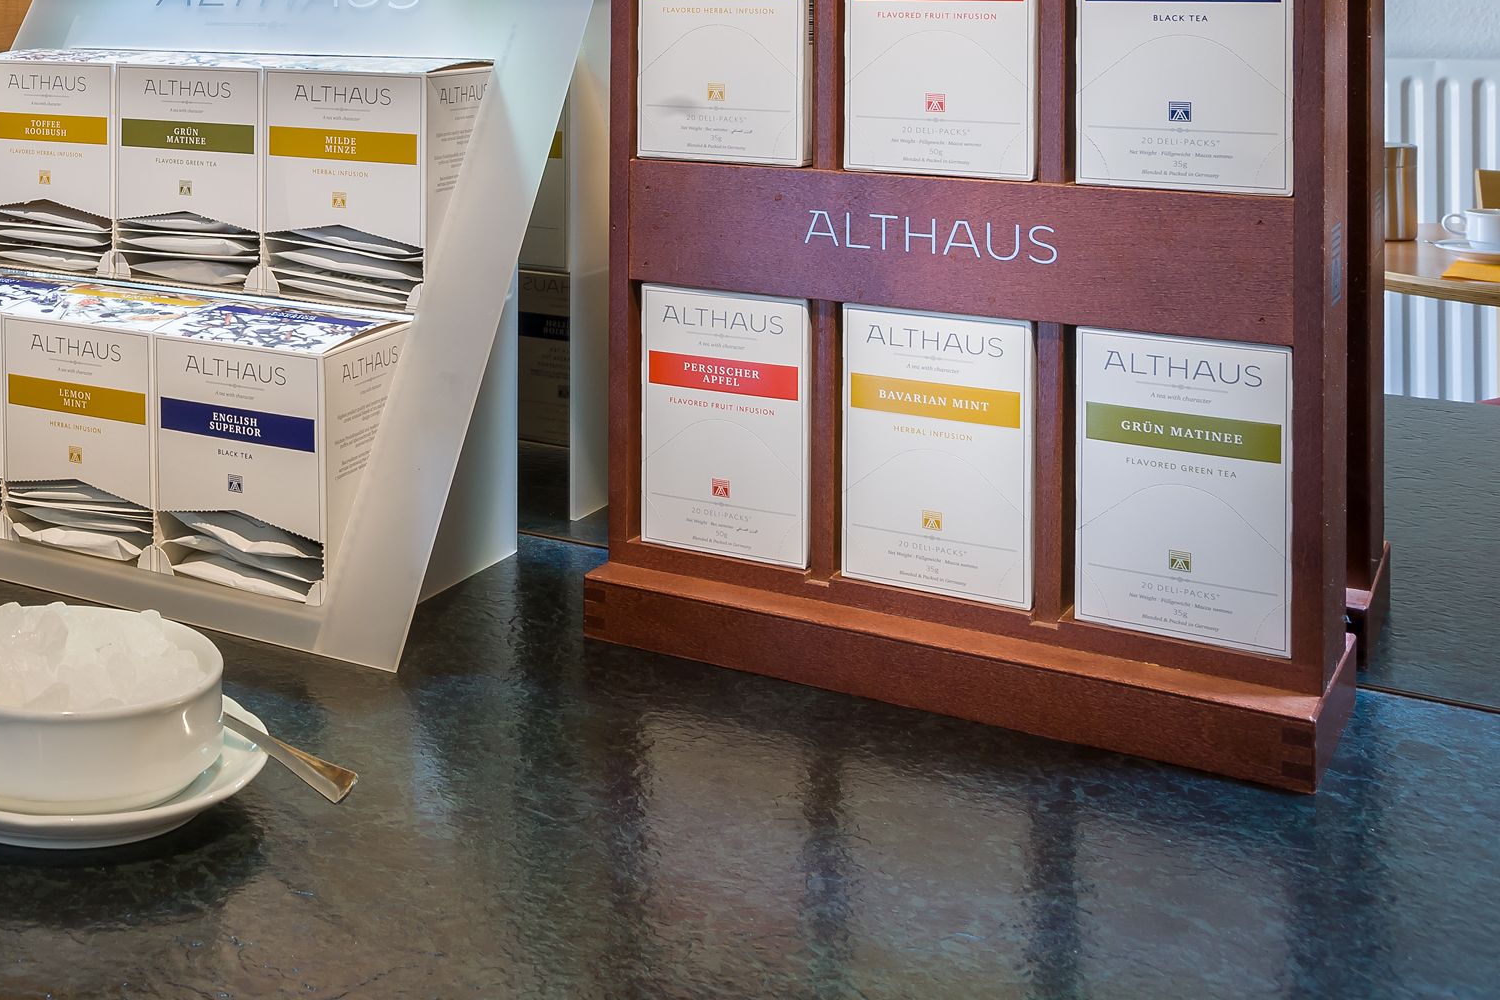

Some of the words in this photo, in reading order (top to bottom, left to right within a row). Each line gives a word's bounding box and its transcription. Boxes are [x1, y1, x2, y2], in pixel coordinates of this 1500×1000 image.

[662, 6, 701, 14] FLAVORED
[735, 7, 775, 15] INFUSION
[877, 11, 922, 19] FLAVORED
[953, 12, 997, 20] INFUSION
[1153, 14, 1185, 22] BLACK
[1189, 14, 1208, 22] TEA
[7, 73, 87, 92] ALTHAUS
[144, 79, 231, 98] ALTHAUS
[294, 84, 392, 106] ALTHAUS
[30, 119, 62, 129] TOFFEE
[902, 126, 913, 134] 20
[25, 128, 67, 137] ROOIBUSH
[173, 126, 199, 136] GRÜN
[166, 135, 206, 145] MATINEE
[325, 136, 357, 146] MILDE
[1141, 137, 1153, 145] 20
[324, 145, 357, 155] MINZE
[155, 157, 184, 166] FLAVORED
[186, 159, 204, 167] GREEN
[206, 160, 217, 168] TEA
[1173, 160, 1188, 169] 35g
[312, 168, 336, 176] HERBAL
[337, 170, 369, 178] INFUSION
[803, 209, 1059, 265] ALTHAUS
[662, 304, 784, 335] ALTHAUS
[30, 333, 122, 362] ALTHAUS
[866, 324, 1004, 359] ALTHAUS
[185, 354, 287, 386] ALTHAUS
[342, 345, 400, 383] ALTHAUS
[1104, 349, 1263, 388] ALTHAUS
[683, 361, 760, 380] PERSISCHER
[702, 374, 740, 387] APFEL
[59, 388, 91, 401] LEMON
[878, 389, 947, 406] BAVARIAN
[952, 398, 989, 412] MINT
[63, 398, 87, 409] MINT
[669, 396, 709, 408] FLAVORED
[711, 402, 733, 411] FRUIT
[736, 405, 775, 416] INFUSION
[212, 412, 258, 427] ENGLISH
[49, 420, 71, 430] HERBAL
[73, 423, 102, 434] INFUSION
[209, 421, 262, 438] SUPERIOR
[1120, 419, 1164, 435] GRÜN
[1170, 426, 1243, 446] MATINEE
[893, 425, 927, 437] HERBAL
[929, 430, 973, 442] INFUSION
[217, 448, 238, 458] BLACK
[240, 452, 253, 460] TEA
[1125, 456, 1177, 470] FLAVORED
[1180, 464, 1213, 476] GREEN
[1217, 469, 1237, 479] TEA
[691, 507, 701, 515] 20
[898, 540, 909, 548] 20
[925, 565, 939, 575] 35g
[1141, 581, 1153, 590] 20
[1173, 608, 1188, 619] 35g
